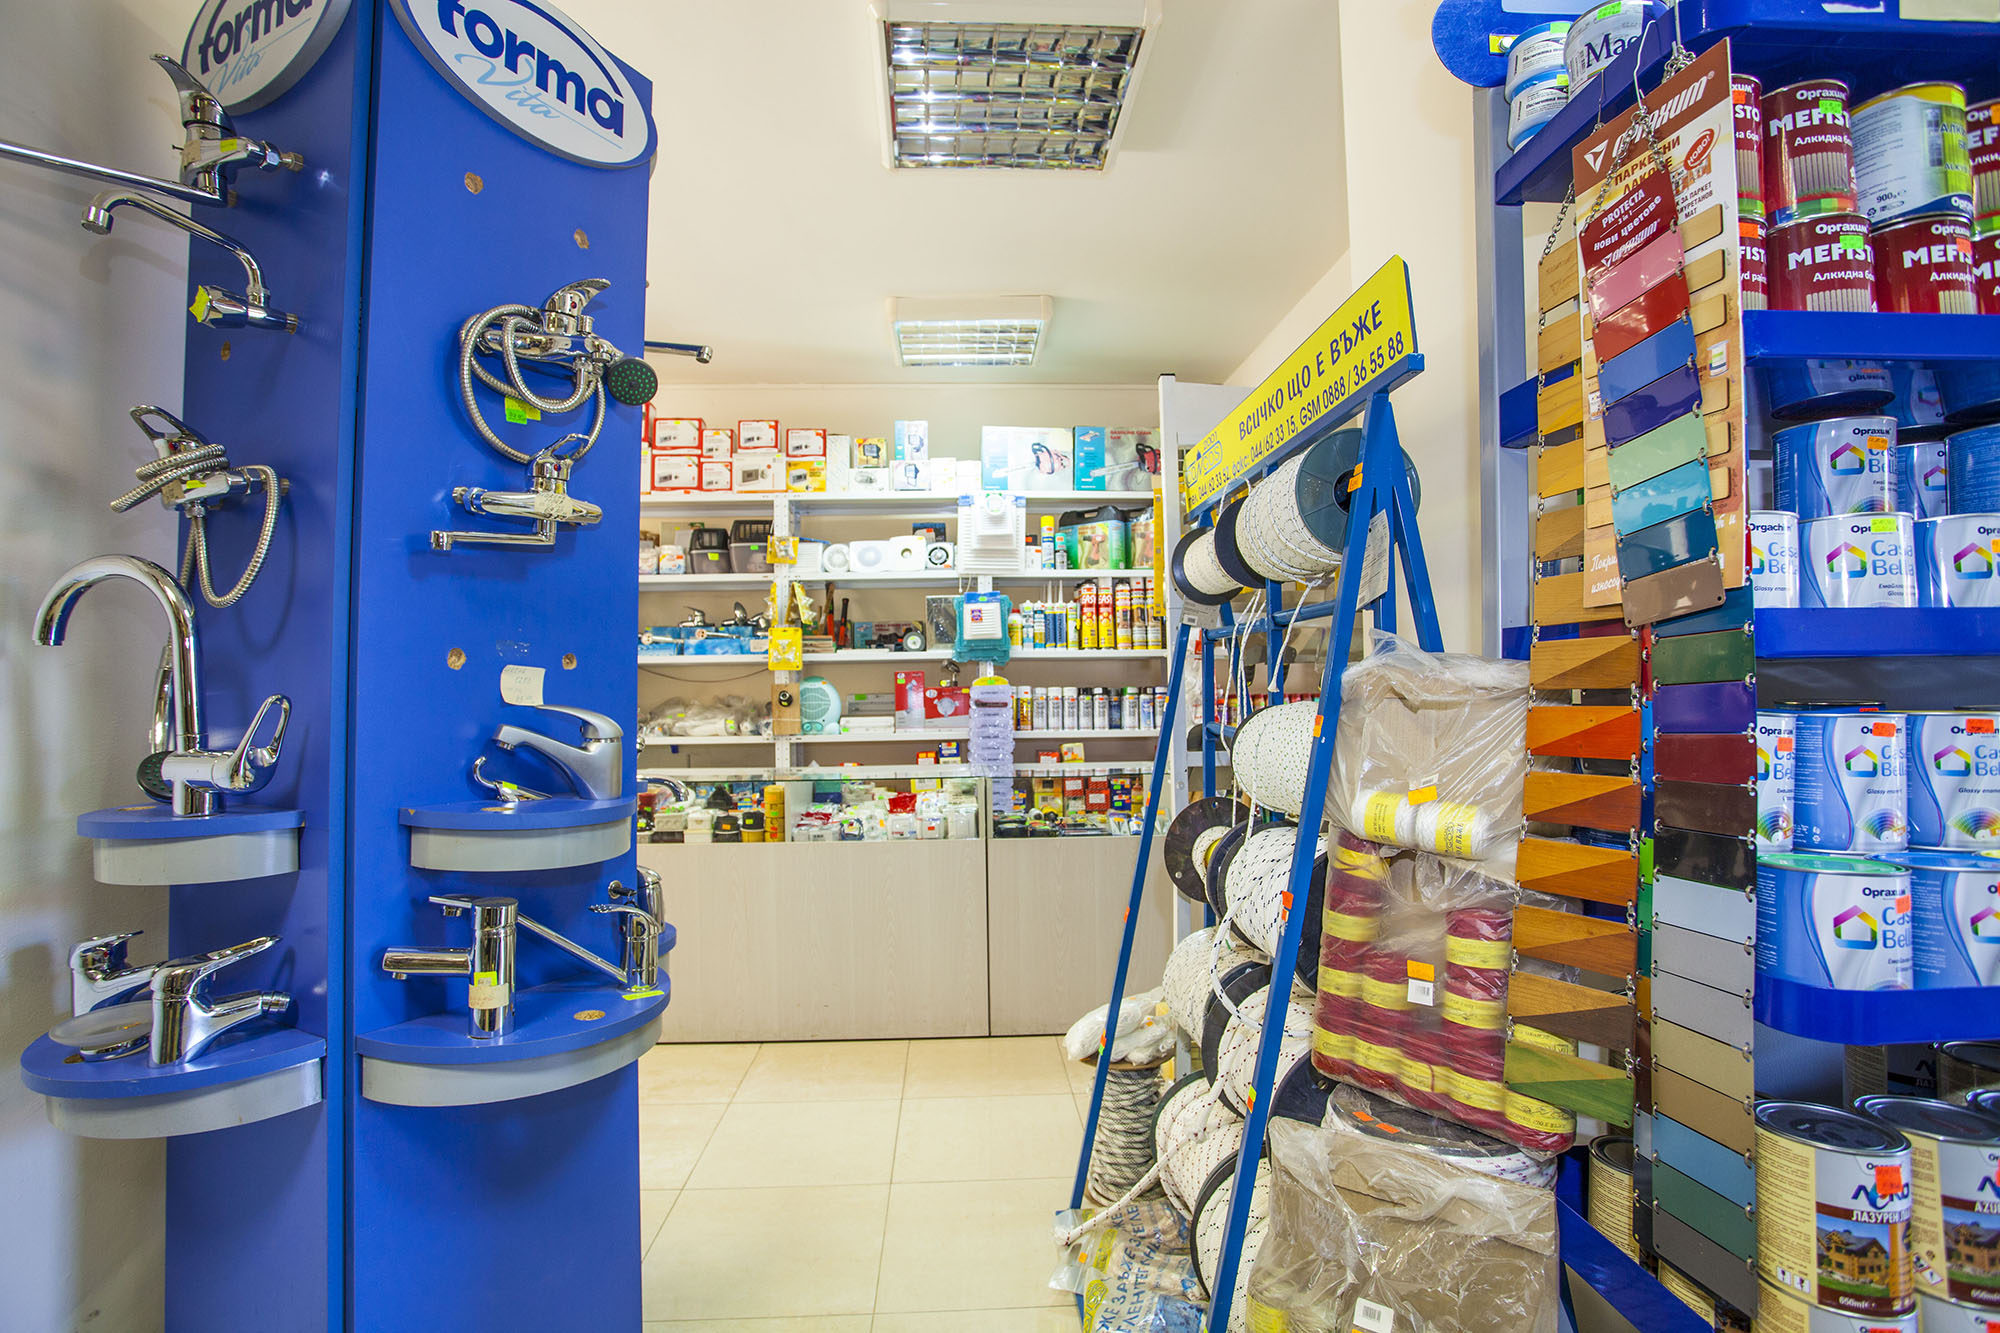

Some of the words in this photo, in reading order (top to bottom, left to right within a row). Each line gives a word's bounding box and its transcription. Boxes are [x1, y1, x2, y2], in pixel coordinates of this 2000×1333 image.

[437, 0, 624, 139] forma
[454, 53, 561, 119] Vita
[1602, 189, 1645, 228] PROTECTA
[1813, 271, 1864, 282] Алкидна
[1239, 387, 1283, 441] ВСИЧКО
[1287, 365, 1311, 401] ЩО
[1330, 300, 1383, 366] ВЪЖЕ
[1299, 395, 1322, 426] GSM
[1353, 359, 1367, 387] 36
[1369, 345, 1385, 374] 55
[1387, 331, 1404, 361] 88
